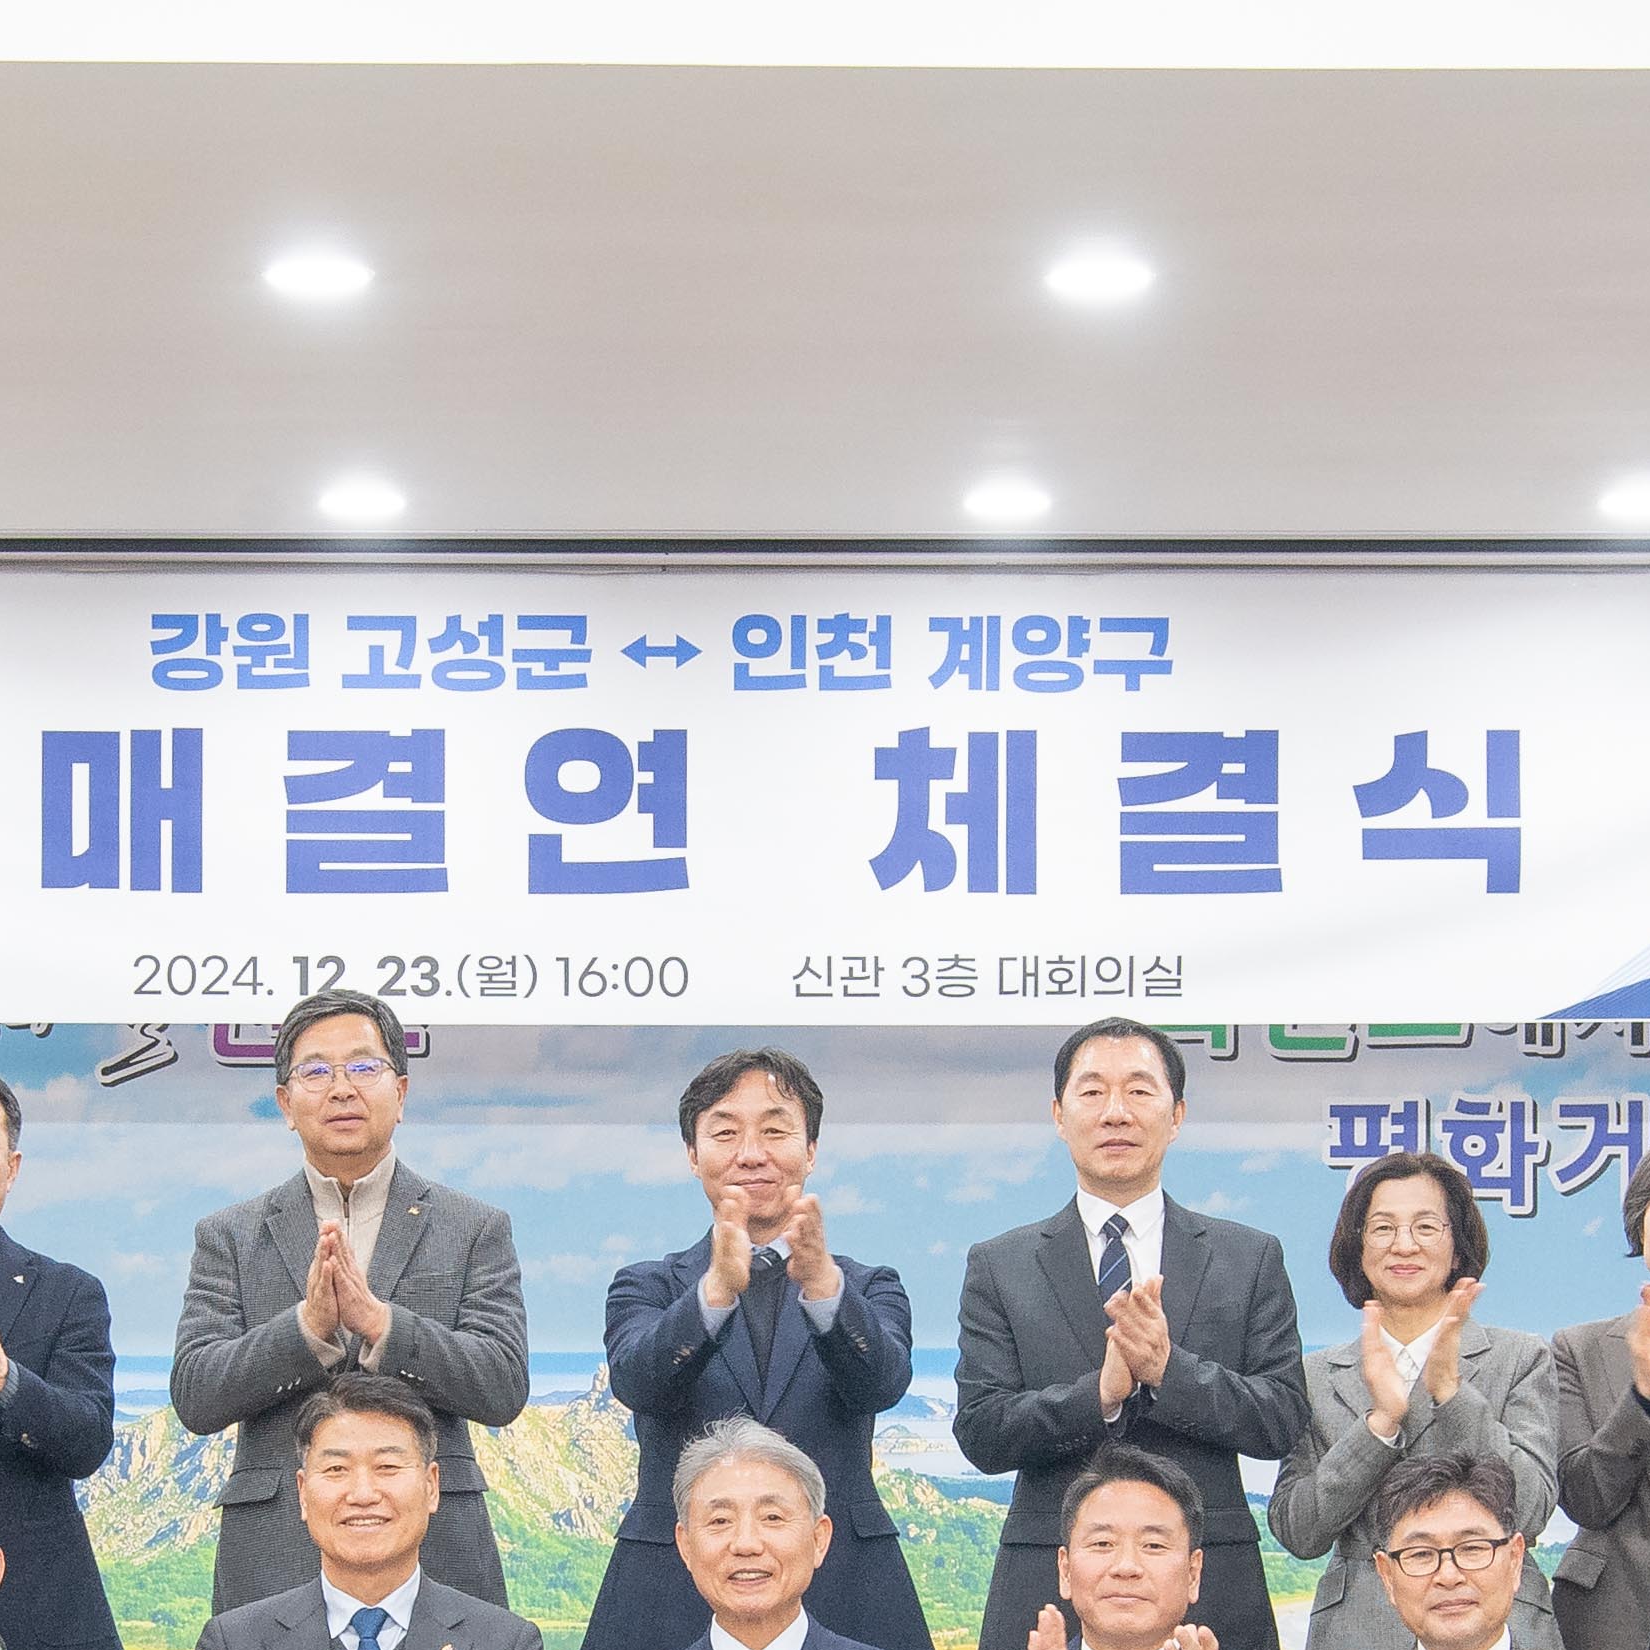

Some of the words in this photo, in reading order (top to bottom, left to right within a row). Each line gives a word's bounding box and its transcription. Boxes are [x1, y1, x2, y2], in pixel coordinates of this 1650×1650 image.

[150, 613, 309, 691] 강원
[343, 614, 592, 691] 고성군
[732, 613, 891, 690] 인천
[929, 615, 1173, 692] 계양구
[869, 727, 1521, 894] 체결식
[133, 955, 273, 996] 2024.
[556, 956, 689, 998] 16:00
[792, 955, 884, 998] 신관
[903, 954, 979, 998] 3층
[999, 955, 1182, 998] 대회의실
